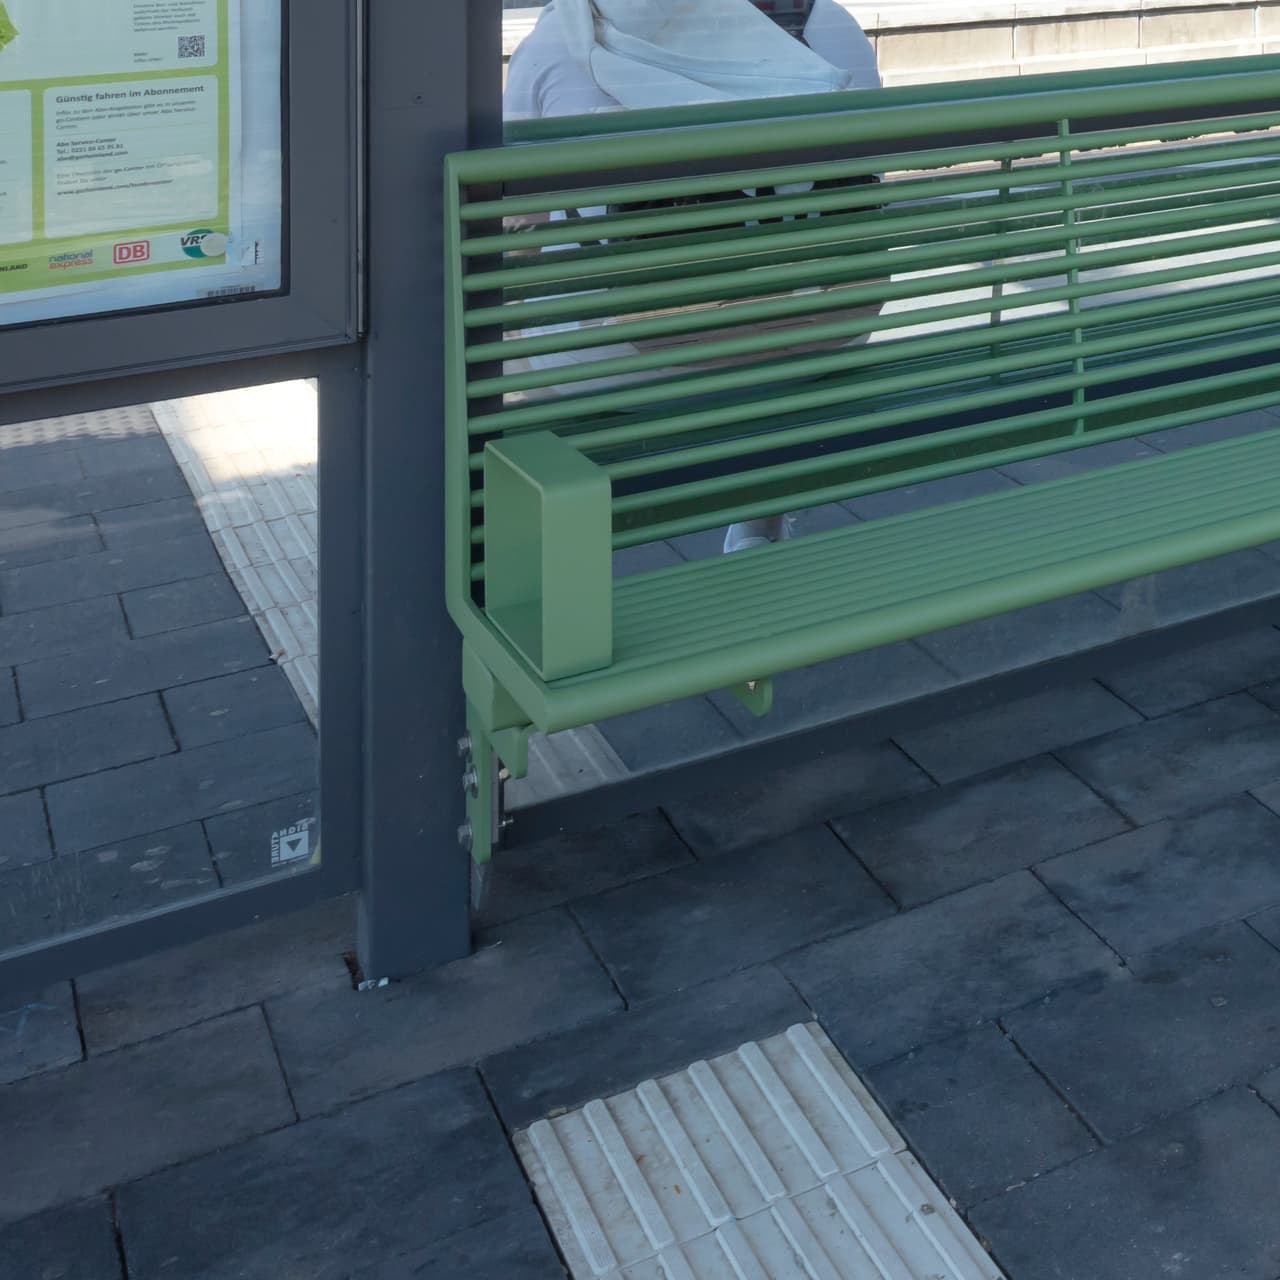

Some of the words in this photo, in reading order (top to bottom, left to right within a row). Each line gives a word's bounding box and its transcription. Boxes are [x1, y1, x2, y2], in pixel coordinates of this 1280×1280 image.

[55, 93, 93, 104] Günstig
[95, 91, 127, 101] fahren
[129, 90, 142, 98] im
[143, 84, 205, 97] Abonnement
[48, 248, 94, 263] national
[118, 244, 145, 261] DB
[48, 259, 94, 271] express
